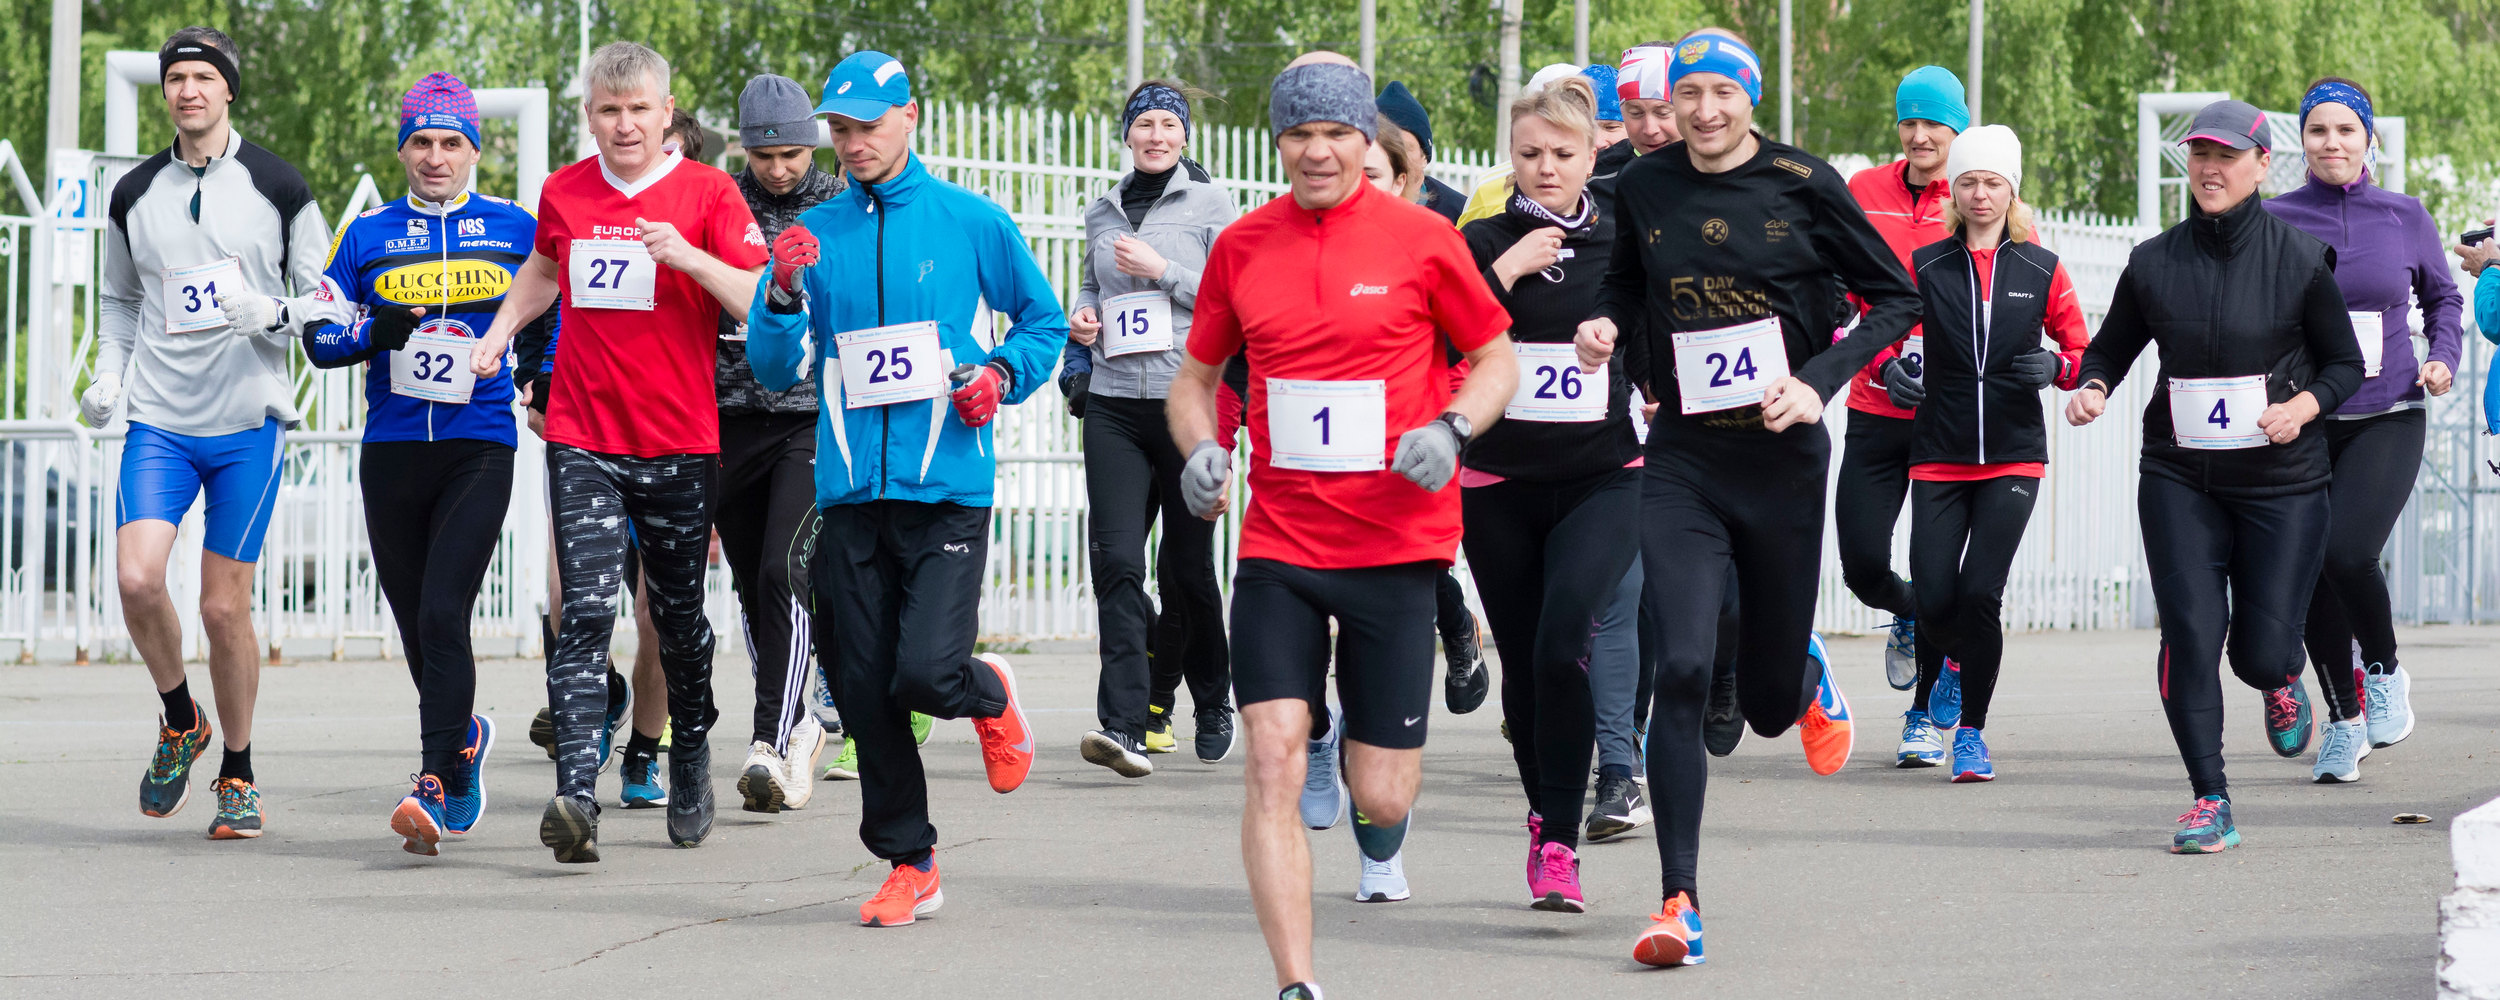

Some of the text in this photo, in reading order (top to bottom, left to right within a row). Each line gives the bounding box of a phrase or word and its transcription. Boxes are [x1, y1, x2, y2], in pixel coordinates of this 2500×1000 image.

[457, 217, 486, 235] ABS
[592, 225, 641, 236] EUROP
[384, 269, 505, 290] LUCCHINI
[587, 258, 630, 289] 27
[1703, 276, 1735, 290] DAY
[182, 280, 219, 313] 31
[393, 286, 495, 301] COSTRUZIONI
[2008, 291, 2029, 299] CRAFT
[1117, 308, 1149, 337] 15
[412, 350, 454, 384] 32
[866, 346, 912, 384] 25
[1705, 346, 1758, 388] 24
[1534, 365, 1583, 400] 26
[1313, 406, 1329, 445] 1
[2208, 398, 2230, 430] 4
